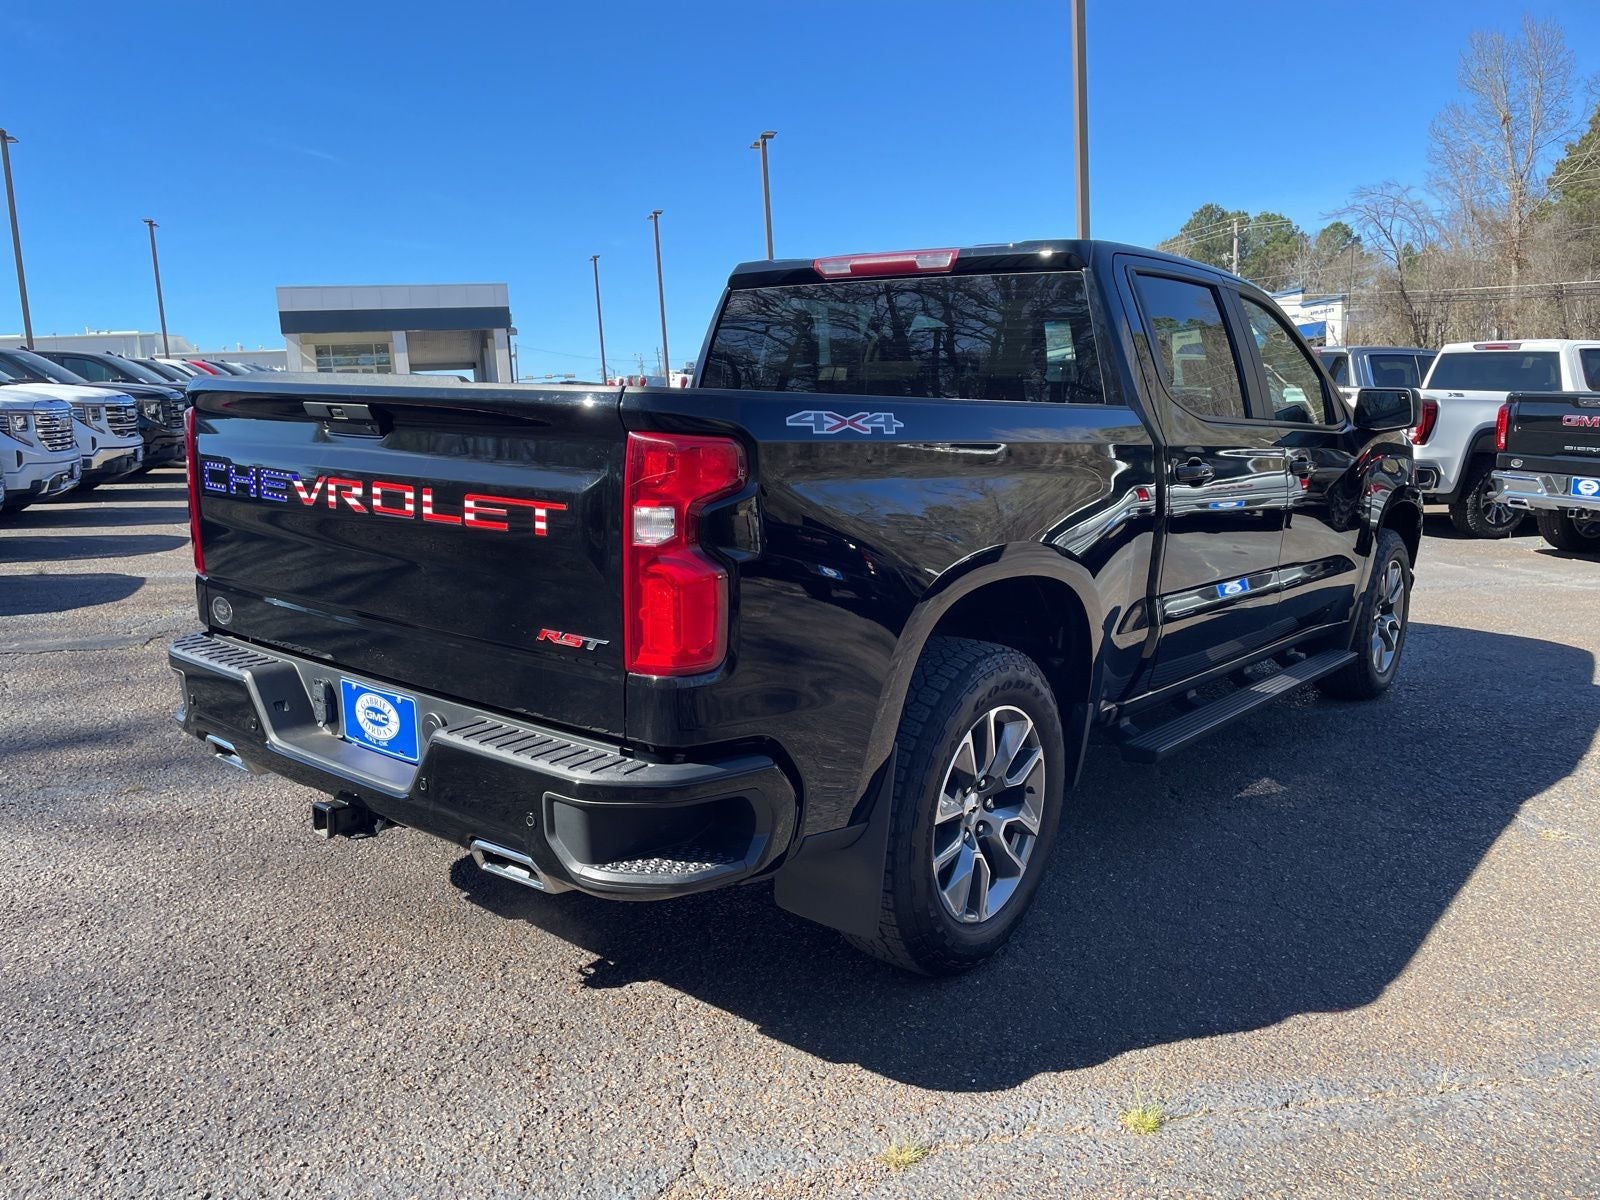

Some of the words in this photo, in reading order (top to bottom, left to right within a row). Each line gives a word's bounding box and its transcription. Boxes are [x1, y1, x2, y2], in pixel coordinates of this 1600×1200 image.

[1562, 415, 1600, 428] GM
[204, 461, 568, 537] CHEVROLET
[536, 628, 609, 650] RST
[365, 709, 388, 724] GMC
